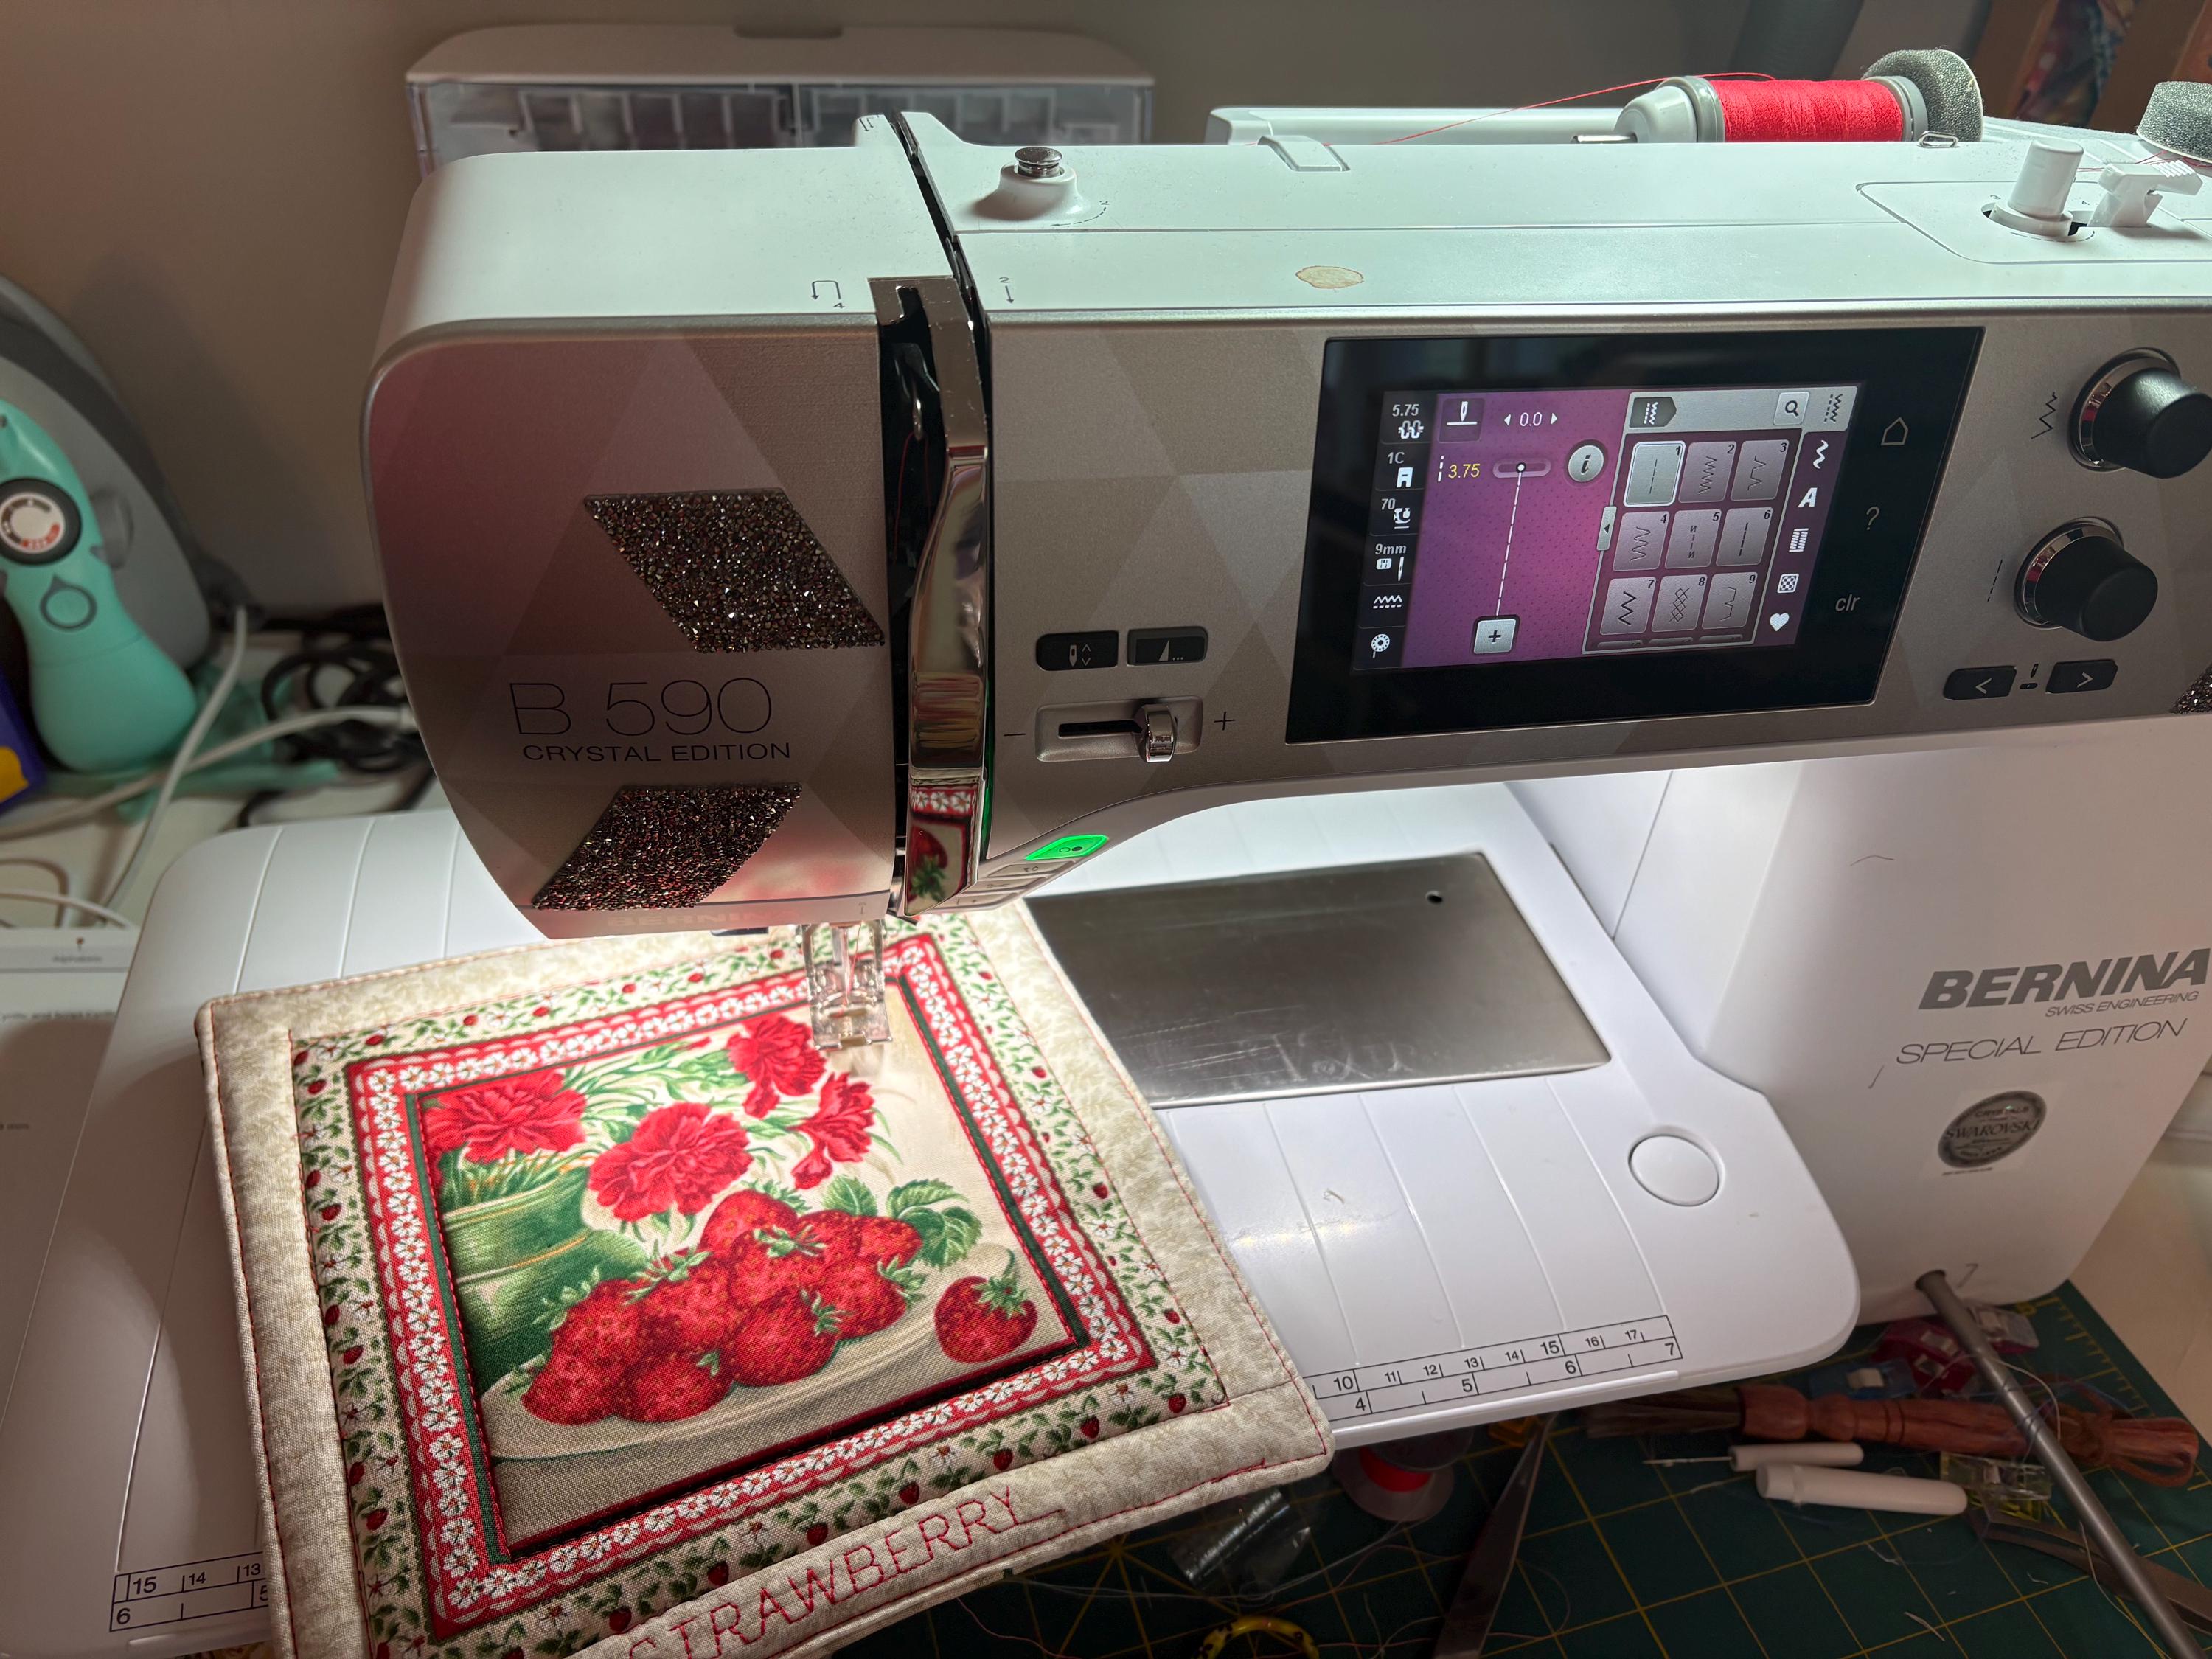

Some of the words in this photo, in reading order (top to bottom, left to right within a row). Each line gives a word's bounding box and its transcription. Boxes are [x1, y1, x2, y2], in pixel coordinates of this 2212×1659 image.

[1392, 403, 1419, 417] 5.75
[1520, 411, 1543, 427] 0.0
[1675, 445, 1681, 456] 1
[1727, 444, 1734, 454] 2
[1780, 442, 1787, 453] 3
[1388, 451, 1405, 465] 1C
[1448, 463, 1481, 479] 3.75
[1381, 498, 1396, 510] 70
[1660, 514, 1667, 524] 4
[1712, 512, 1719, 522] 5
[1763, 509, 1770, 520] 6
[1375, 543, 1407, 555] 9mm
[1648, 580, 1655, 589] 7
[1698, 577, 1705, 587] 8
[1749, 574, 1756, 584] 9
[1835, 594, 1861, 612] clr
[509, 682, 571, 734] B
[605, 678, 772, 737] 590
[523, 745, 661, 762] CRYSTAL
[671, 742, 790, 762] EDITION
[1918, 947, 2211, 1010] BERNINA
[2045, 1003, 2096, 1018] SWISS
[2096, 990, 2199, 1012] ENGINEERING
[1896, 1035, 2042, 1065] SPECIAL
[2055, 1018, 2188, 1051] EDITION
[1333, 1376, 1354, 1391] 10
[1385, 1371, 1396, 1383] 11
[1423, 1364, 1437, 1377] 12
[1464, 1357, 1479, 1369] 13
[1505, 1350, 1520, 1363] 14
[1540, 1340, 1559, 1357] 15
[1585, 1336, 1599, 1348] 16
[1625, 1329, 1638, 1341] 17
[1355, 1397, 1366, 1412] 4
[1462, 1378, 1473, 1394] 5
[1565, 1360, 1576, 1375] 6
[1665, 1342, 1676, 1357] 7
[133, 1576, 157, 1595] 15
[188, 1571, 206, 1585] 14
[243, 1562, 261, 1577] 13
[116, 1607, 131, 1624] 6
